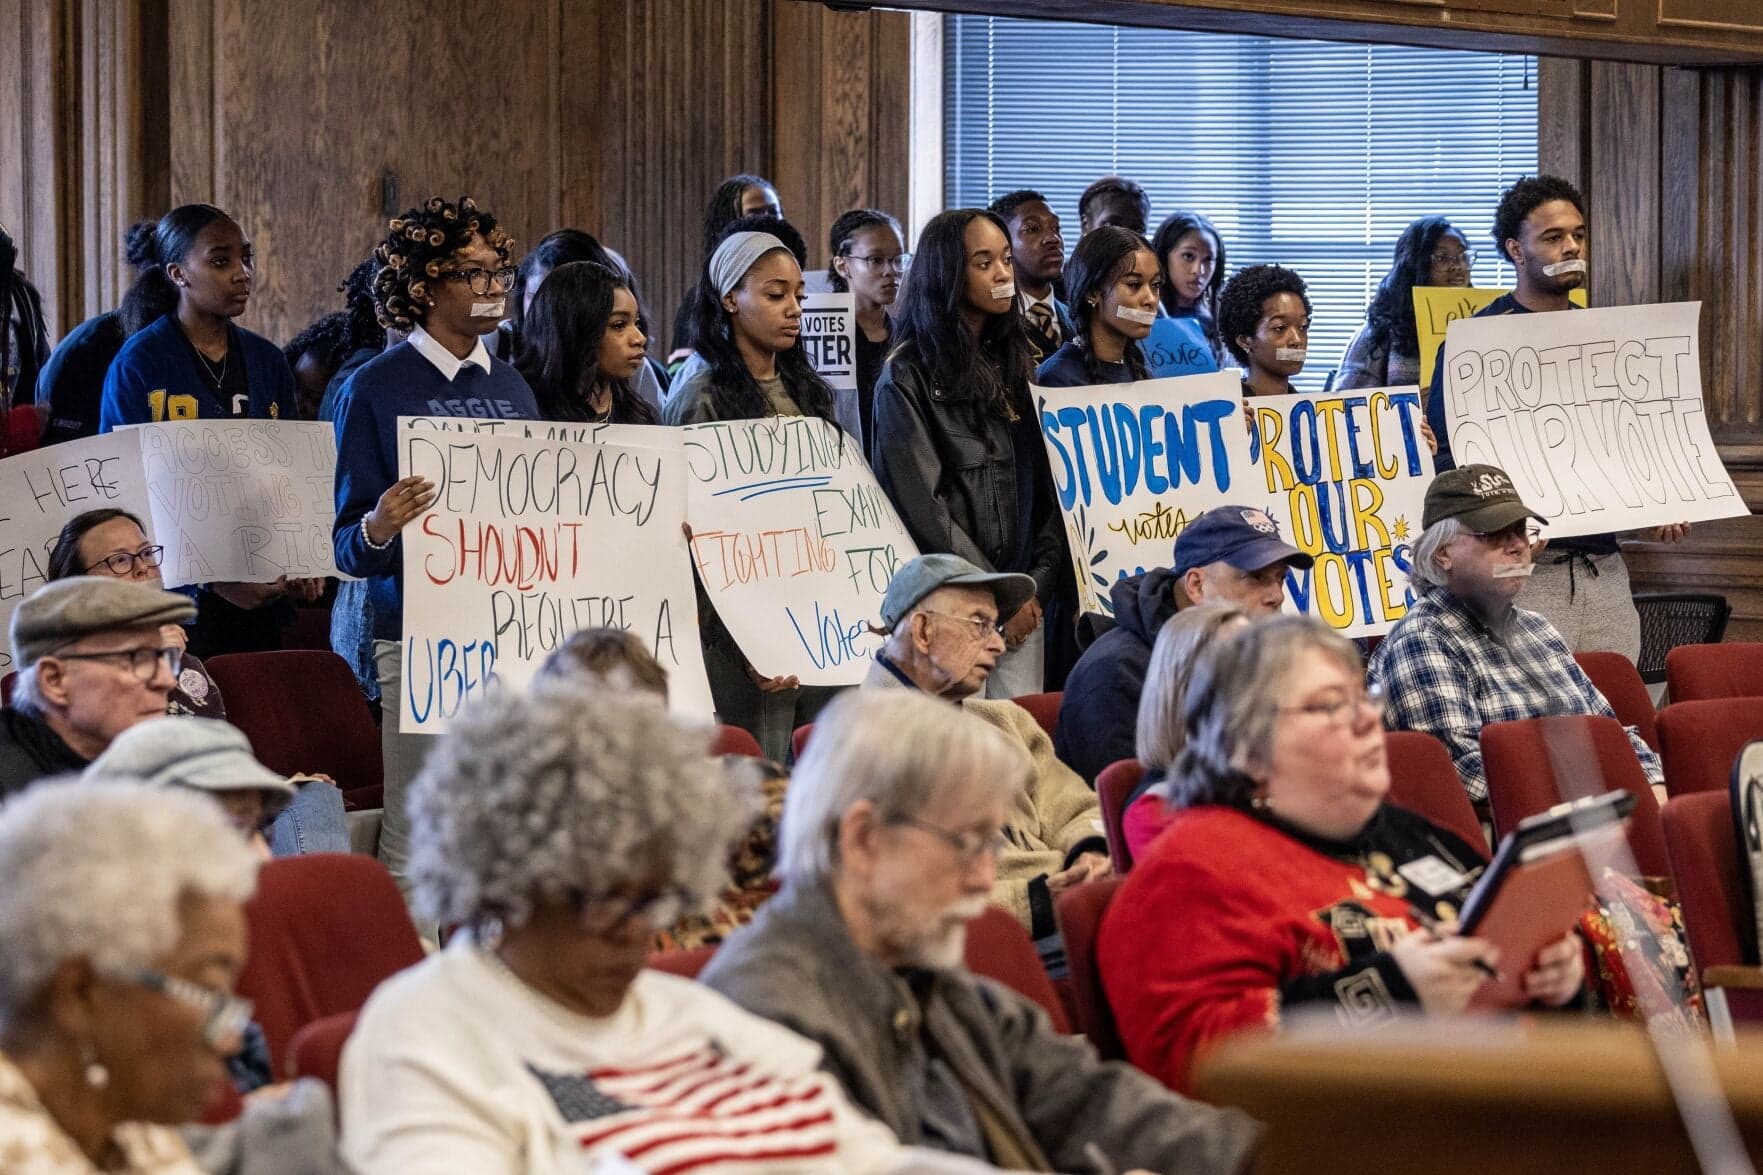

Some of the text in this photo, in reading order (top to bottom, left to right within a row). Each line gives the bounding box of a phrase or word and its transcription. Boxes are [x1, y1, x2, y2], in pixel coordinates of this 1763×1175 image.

[805, 317, 845, 333] VOTES
[1449, 336, 1691, 418] PROTECT
[24, 457, 120, 513] HERE
[143, 422, 336, 483] ACCESS T
[410, 438, 660, 526] DEMOCRACY
[1042, 400, 1236, 511] STUDENT
[1575, 398, 1735, 508] VOTE
[150, 472, 302, 527] VOTING
[1288, 478, 1392, 555] OUR
[177, 529, 215, 581] A
[693, 527, 836, 592] FIGHTING
[655, 599, 679, 665] A
